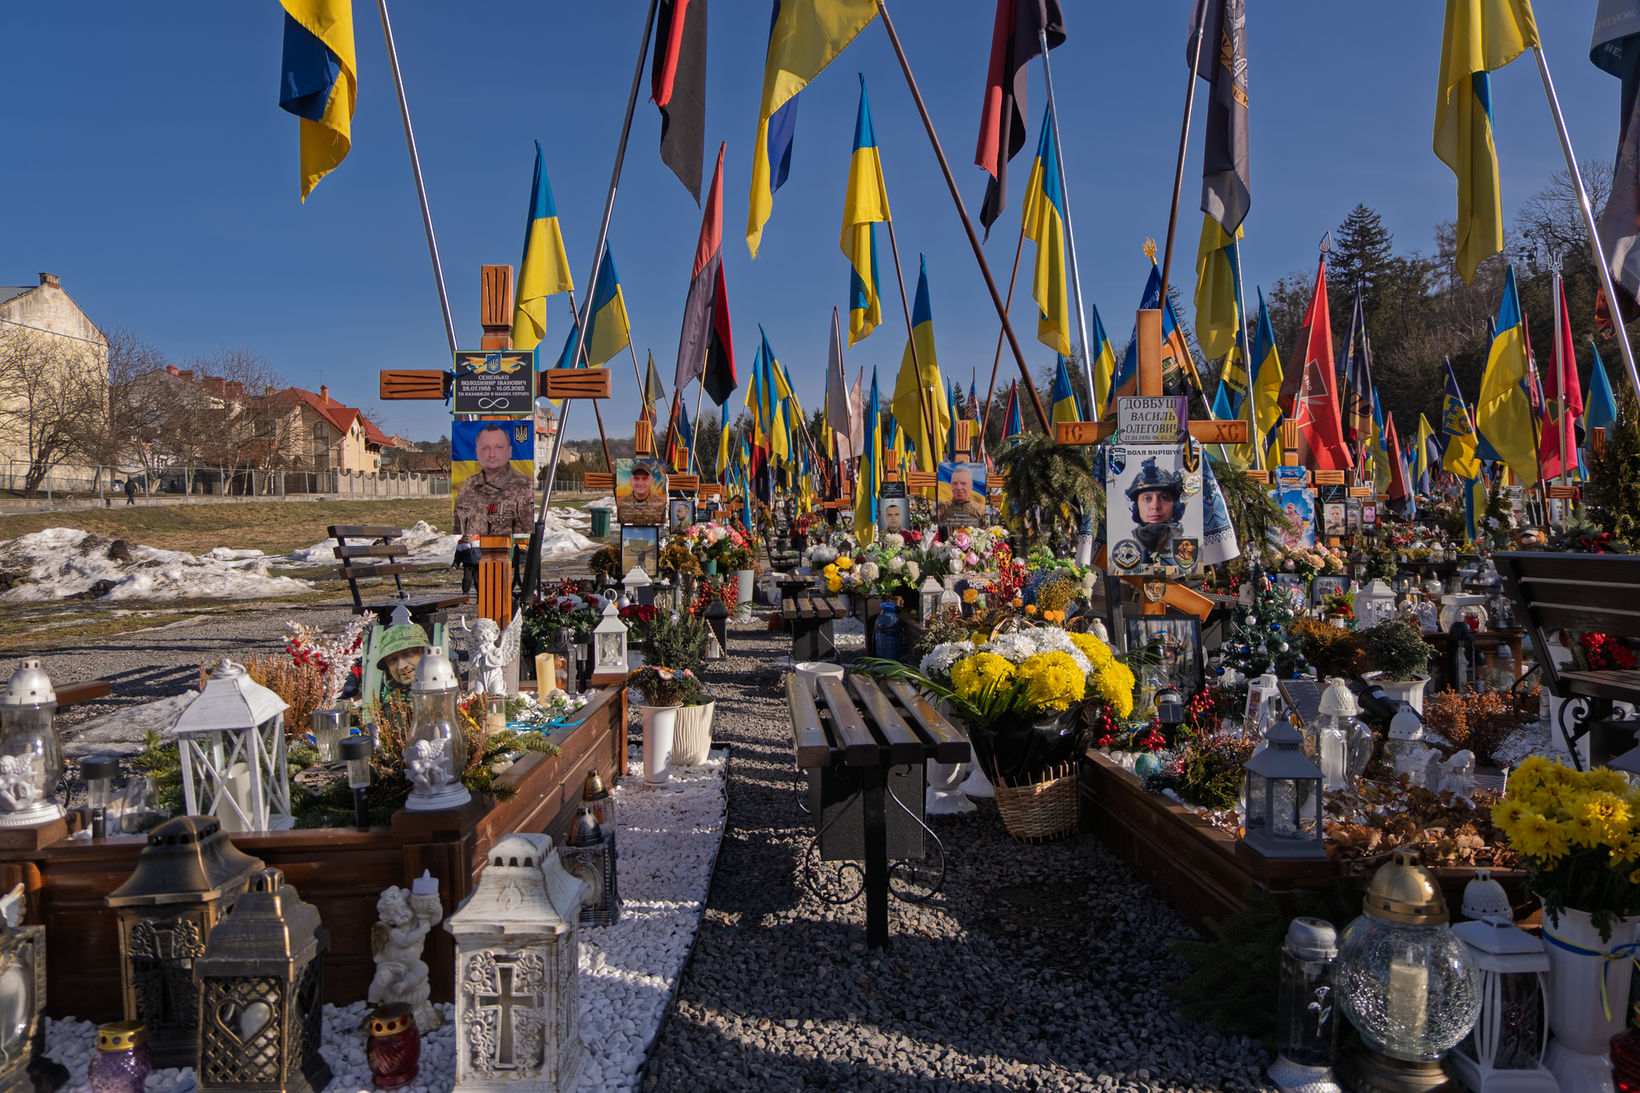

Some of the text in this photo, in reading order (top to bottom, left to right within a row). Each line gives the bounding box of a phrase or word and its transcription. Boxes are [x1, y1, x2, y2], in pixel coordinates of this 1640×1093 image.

[1124, 398, 1177, 410] ДОВБУШ
[1130, 412, 1176, 421] ВАСИЛЬ
[1126, 423, 1180, 433] ОЛЕГОВИЧ
